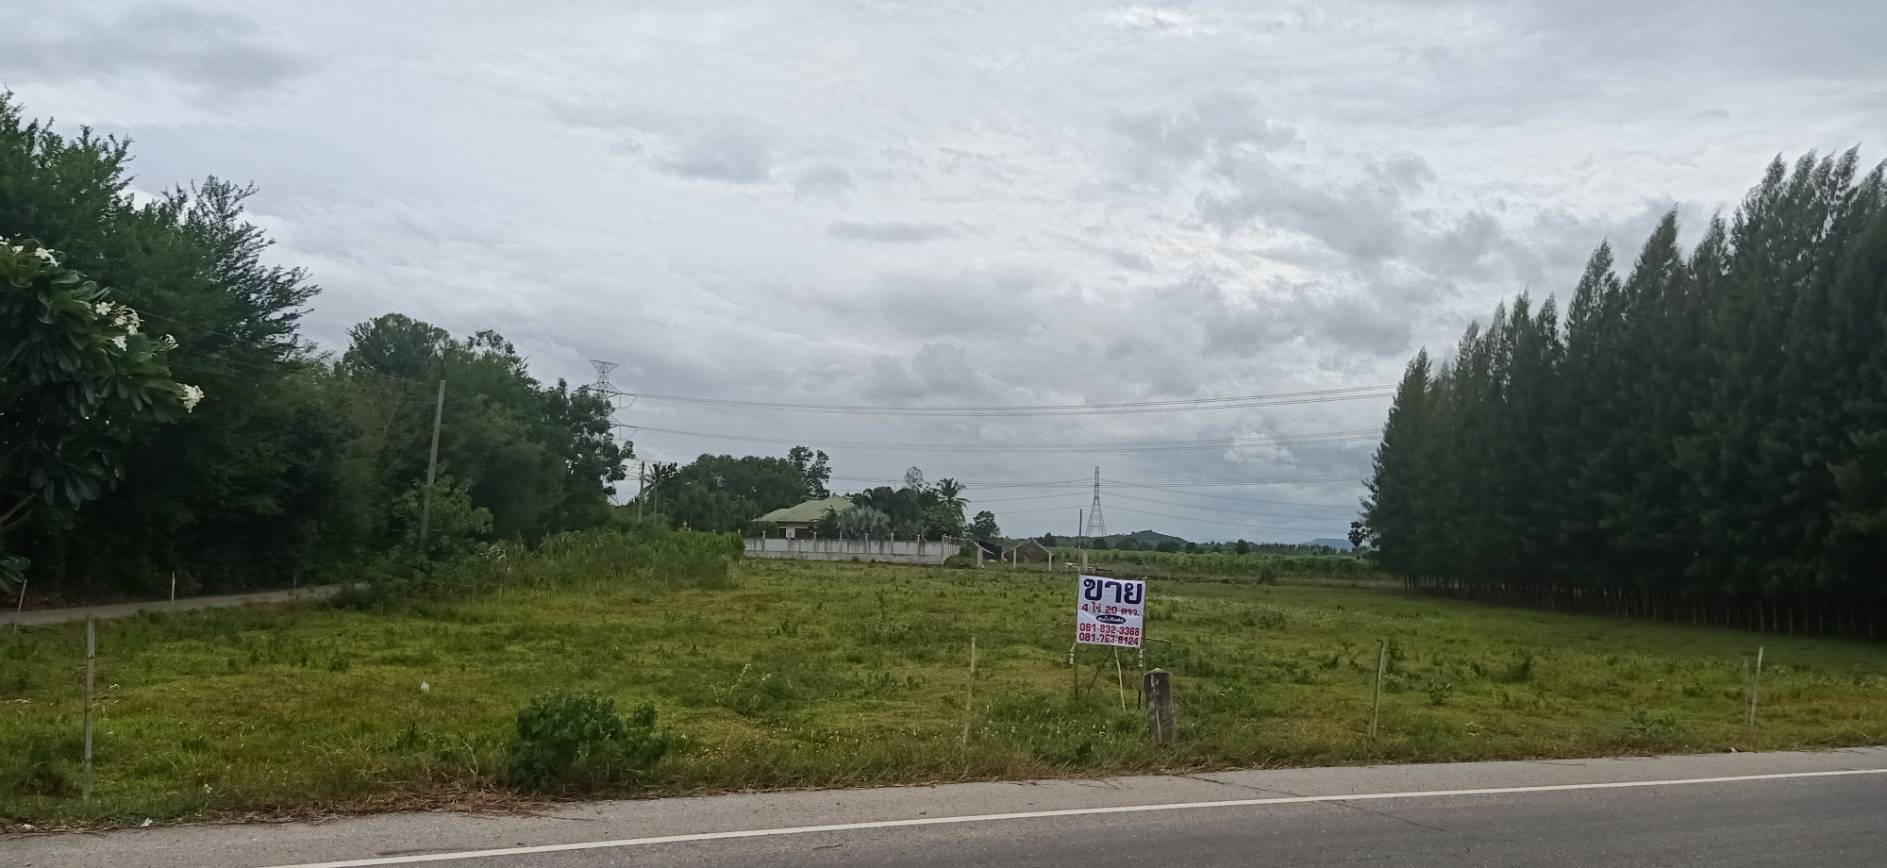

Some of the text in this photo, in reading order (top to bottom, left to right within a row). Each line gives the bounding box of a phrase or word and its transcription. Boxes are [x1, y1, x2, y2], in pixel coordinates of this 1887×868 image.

[1084, 579, 1142, 604] ขาย
[1092, 602, 1101, 612] ไร่
[1105, 606, 1117, 614] 20
